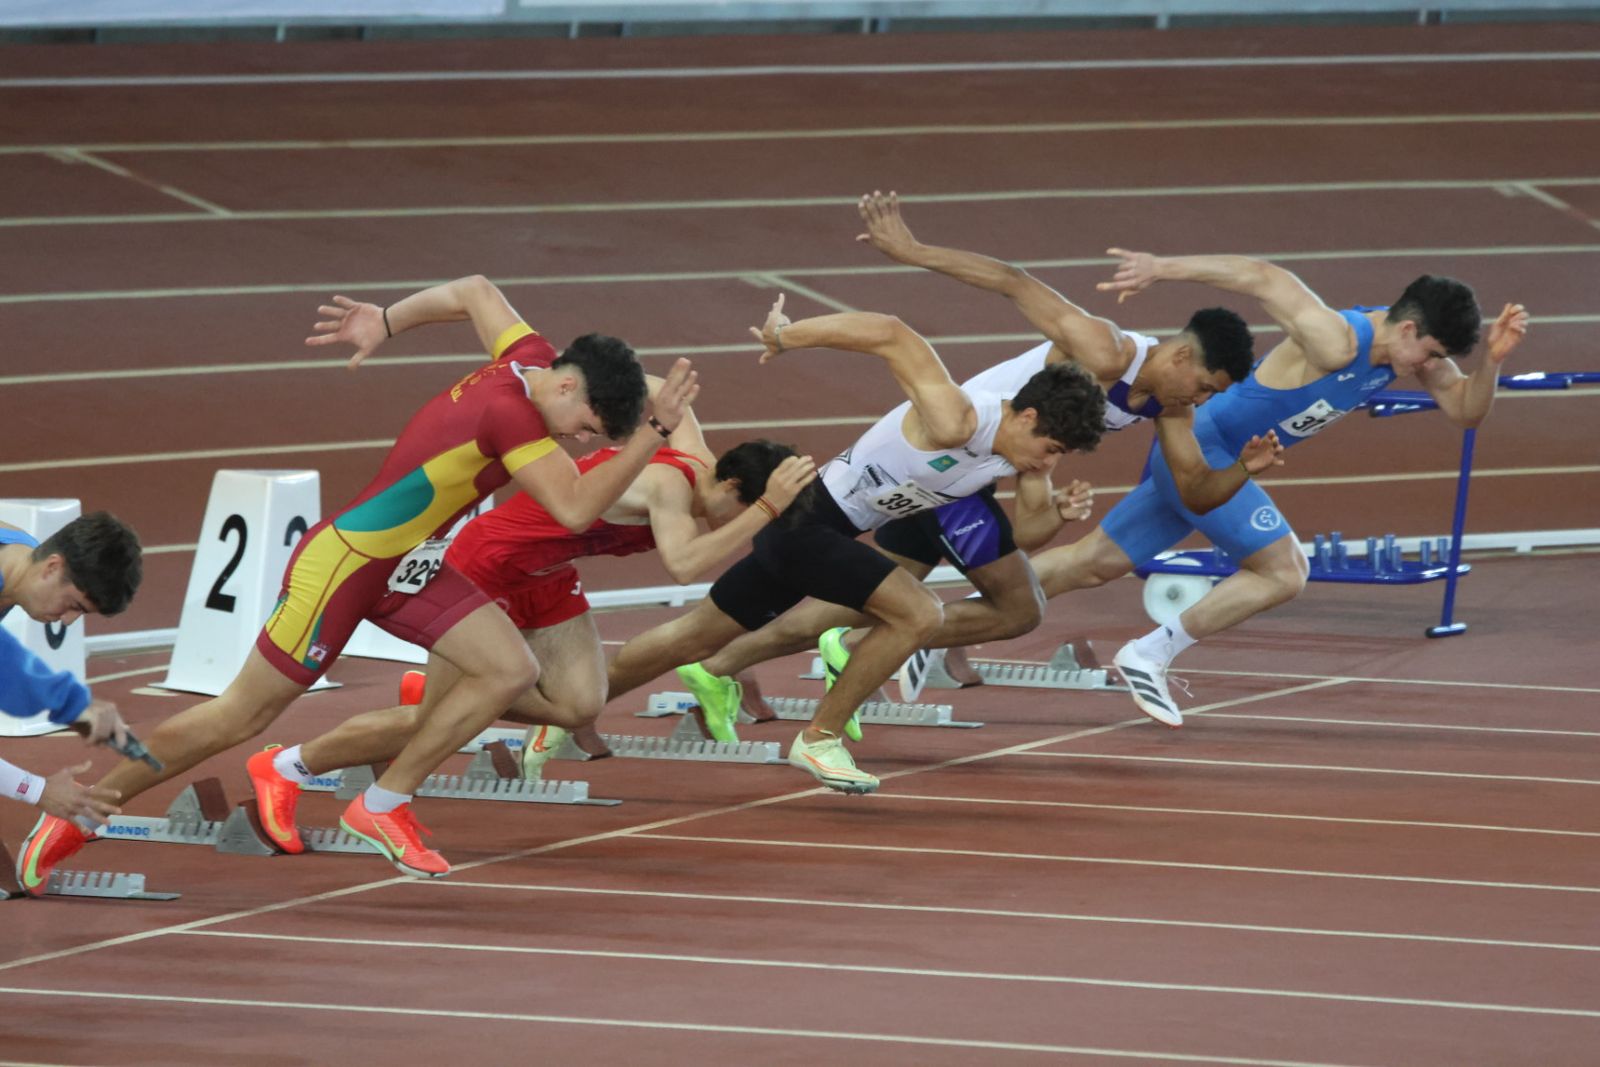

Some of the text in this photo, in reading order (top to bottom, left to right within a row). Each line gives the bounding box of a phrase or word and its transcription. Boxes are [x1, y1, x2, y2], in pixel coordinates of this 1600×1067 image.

[877, 493, 923, 515] 391
[205, 514, 247, 613] 2
[106, 825, 150, 836] MONDO
